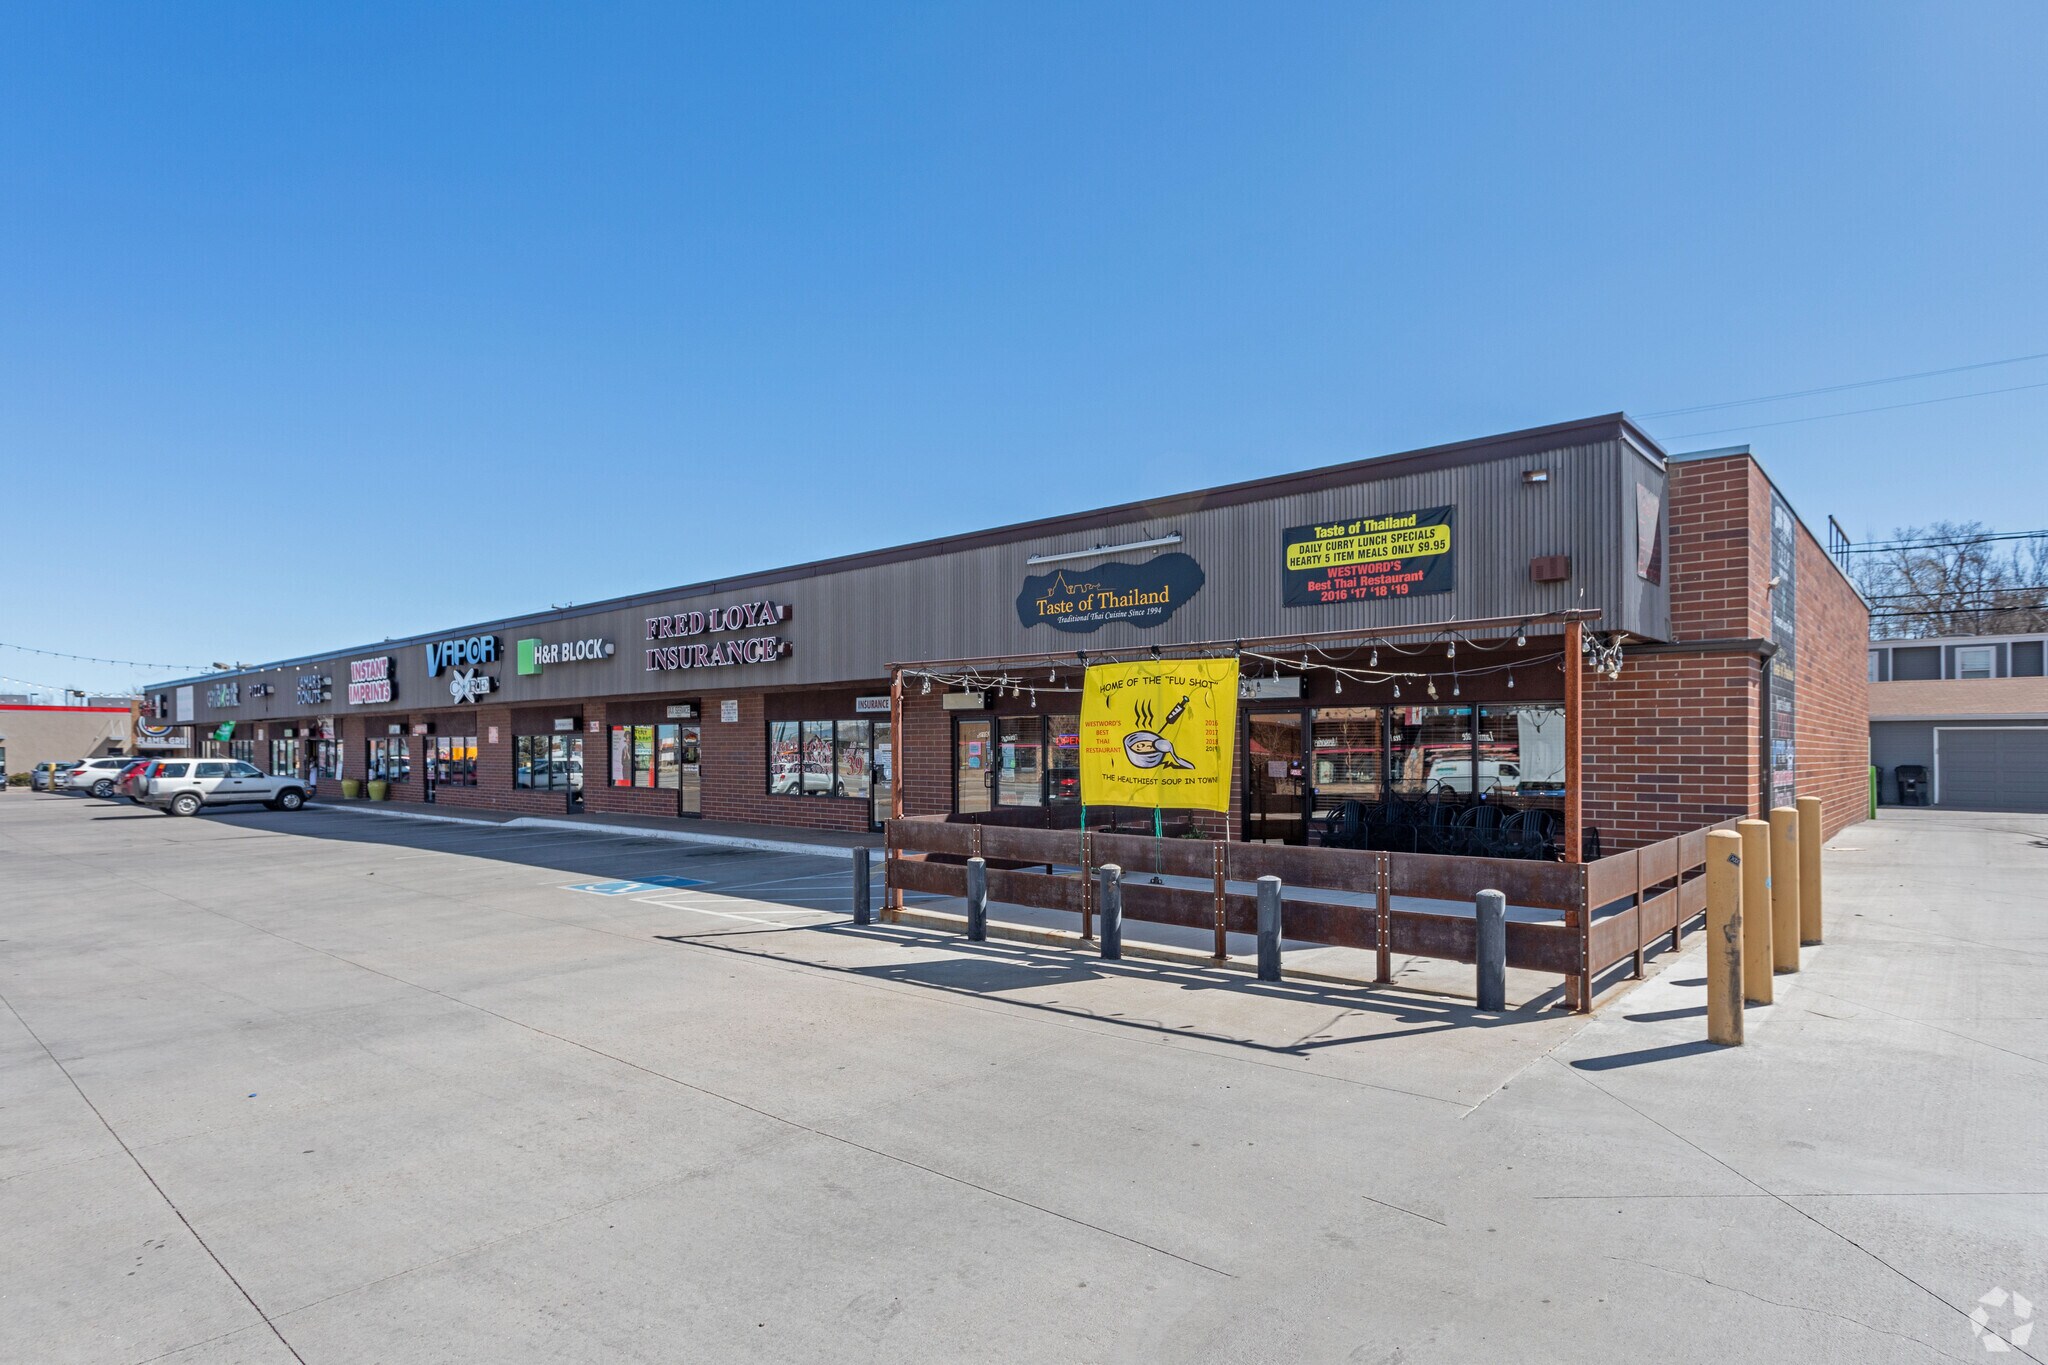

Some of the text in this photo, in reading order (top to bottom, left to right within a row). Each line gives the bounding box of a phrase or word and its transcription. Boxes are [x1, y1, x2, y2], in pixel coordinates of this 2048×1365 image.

[1314, 514, 1416, 539] Taste of Thailand
[1290, 539, 1446, 567] HEARTY 5 ITEM MEALS ONLY $9.95
[1299, 529, 1435, 555] DAILY CURRY LUNCH SPECIALS
[1308, 570, 1424, 592] Best Thai Restaurant
[1327, 560, 1402, 578] WESTWORD'S
[1036, 585, 1170, 616] Taste of Thailand
[1321, 591, 1348, 602] 2016
[645, 600, 778, 641] FRED LOYA
[1057, 607, 1162, 624] Traditional Thai Cuisine Since 1994
[426, 635, 495, 678] VAPOR
[534, 638, 603, 665] H&R BLOCK
[645, 636, 778, 671] INSURANCE
[351, 656, 389, 683] INSTANT
[297, 689, 321, 705] DONUTS
[348, 679, 391, 705] IMPRINTS
[1100, 680, 1123, 693] HOME
[1127, 678, 1139, 687] OF
[1143, 676, 1162, 685] THE
[858, 699, 889, 709] INSURANCE
[1085, 720, 1122, 728] WESTWORD'S
[1117, 775, 1159, 785] HEALTHIEST
[1161, 777, 1182, 785] SOUP
[1185, 777, 1196, 785] IN
